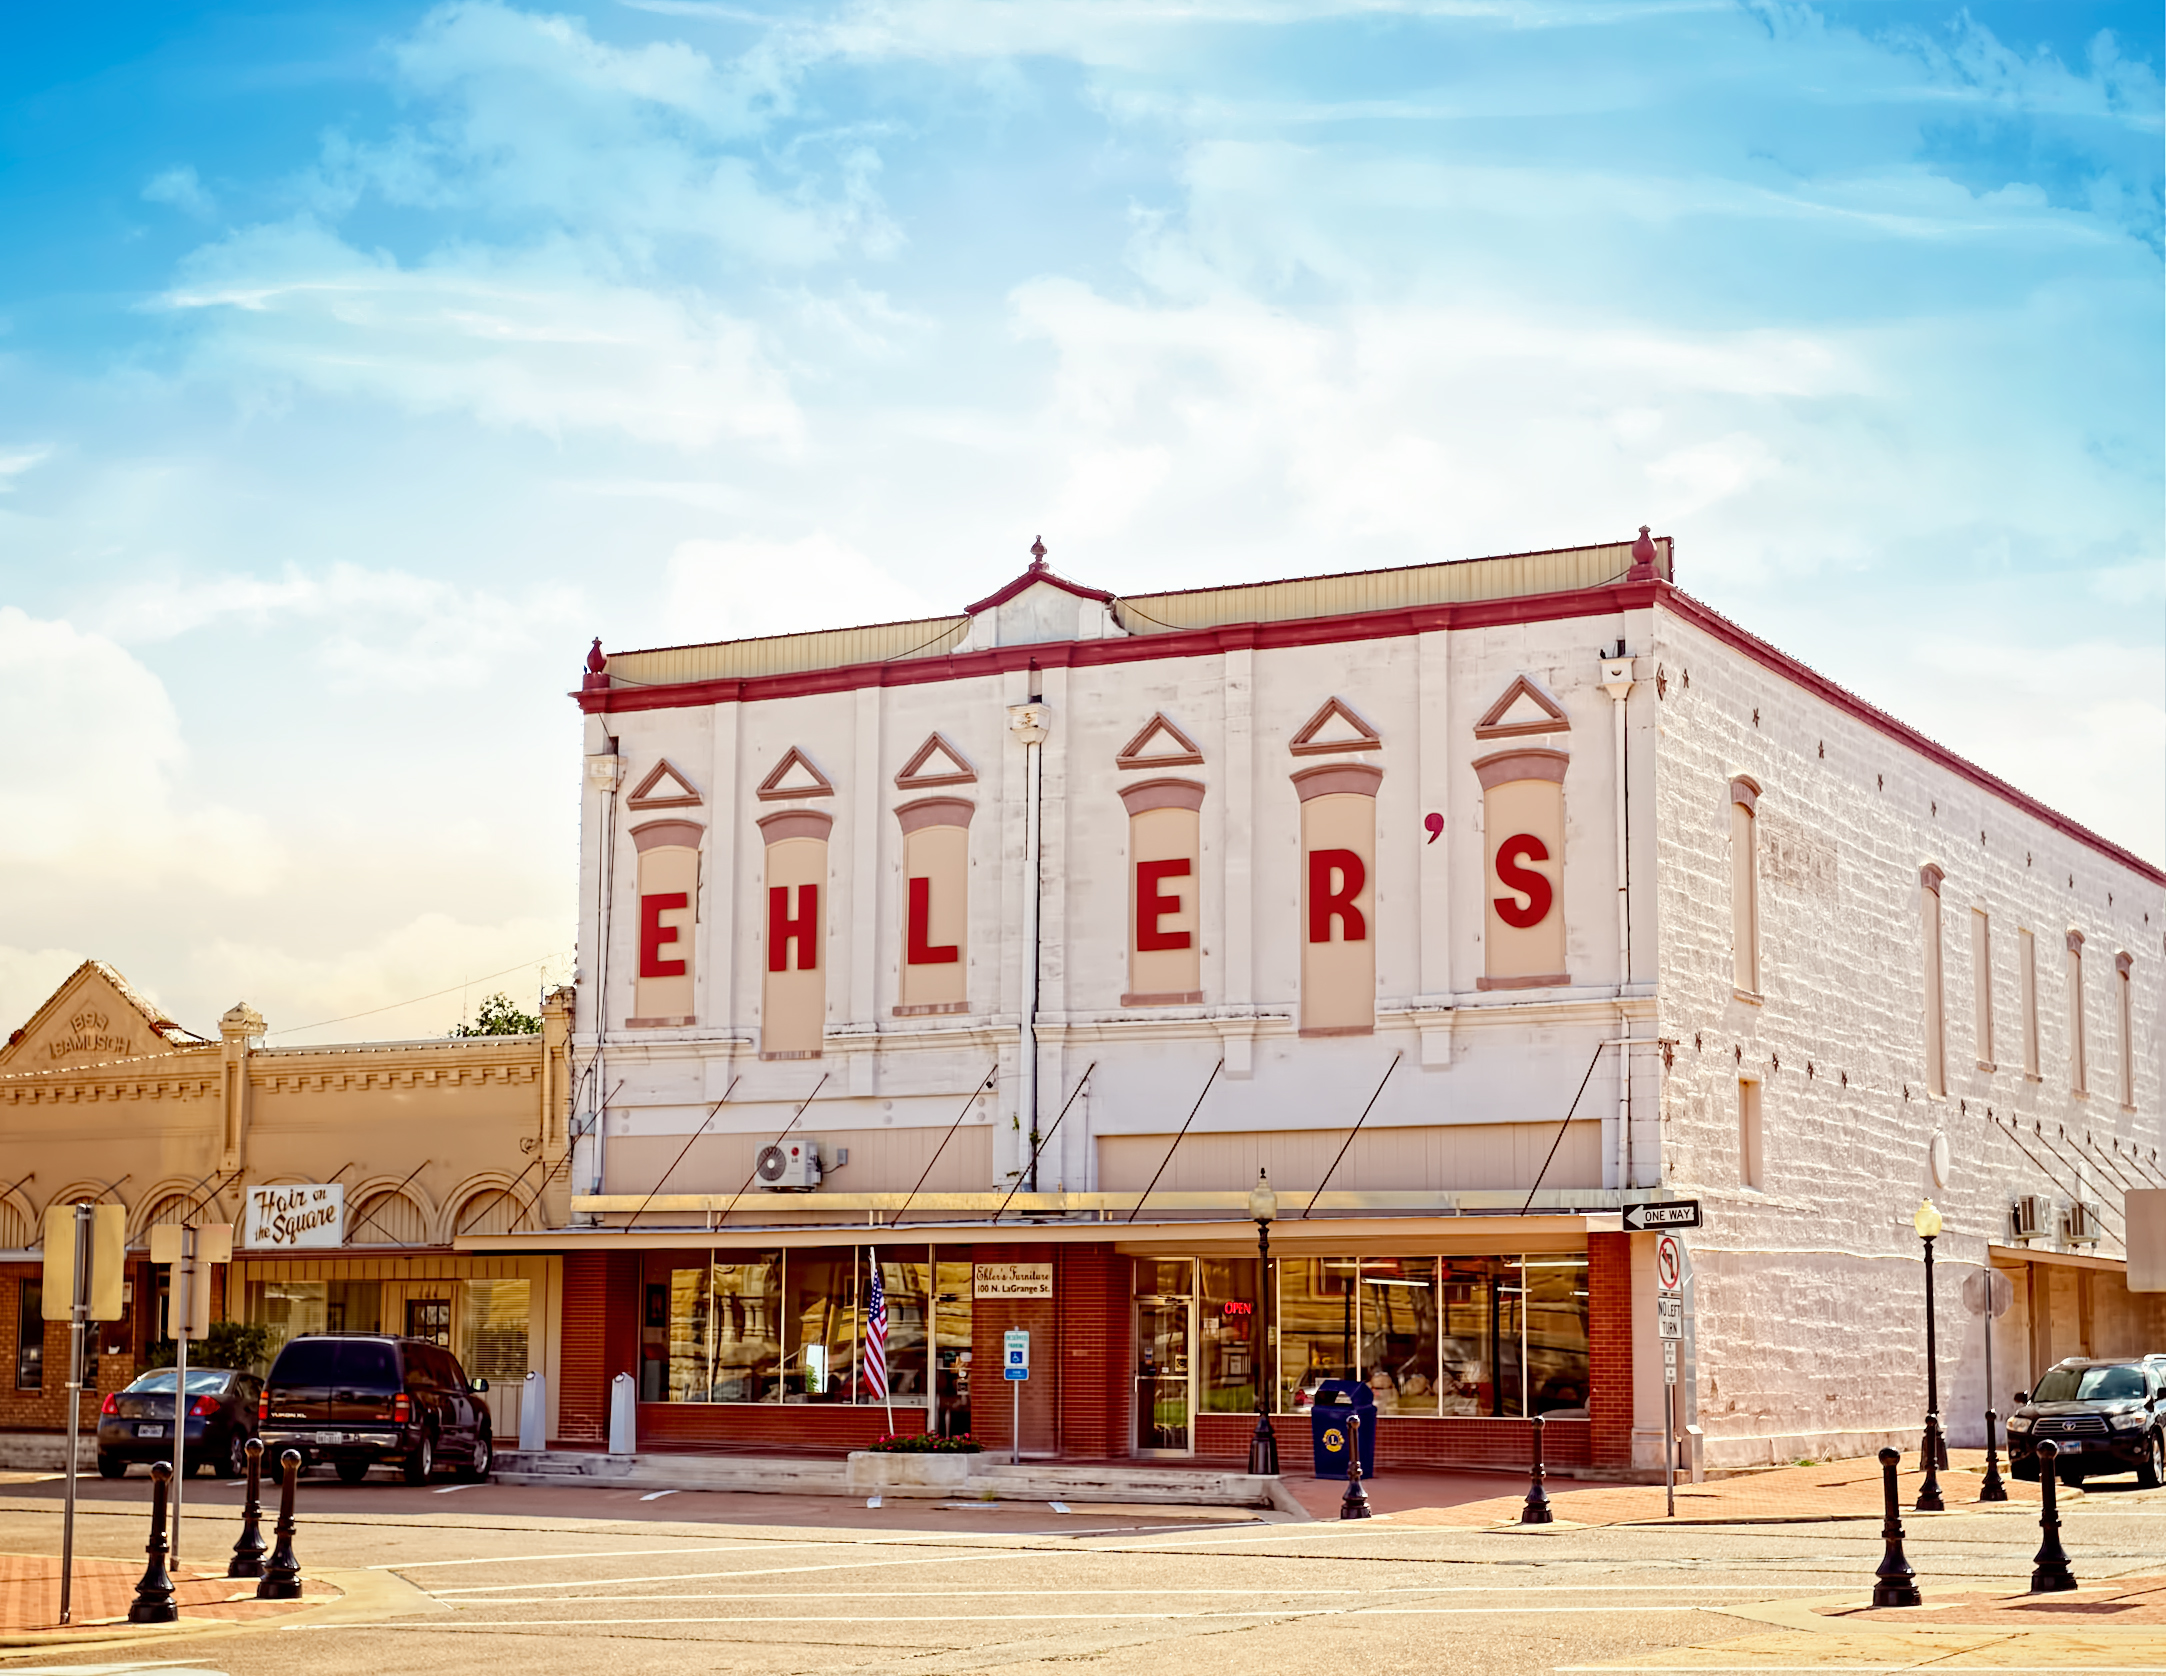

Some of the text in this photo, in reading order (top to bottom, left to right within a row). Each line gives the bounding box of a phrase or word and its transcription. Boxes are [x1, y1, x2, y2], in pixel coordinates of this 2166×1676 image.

[640, 813, 1552, 977] EHLER'S
[254, 1188, 327, 1225] Hair on
[1645, 1208, 1691, 1222] ONE WAY
[272, 1205, 336, 1245] Square
[976, 1265, 1049, 1281] Ehler's Furniture
[977, 1284, 989, 1293] 100
[1002, 1284, 1038, 1295] LaGrange
[1224, 1301, 1252, 1315] OPEN
[1658, 1300, 1681, 1318] NO LEFT
[1662, 1321, 1678, 1336] TURN
